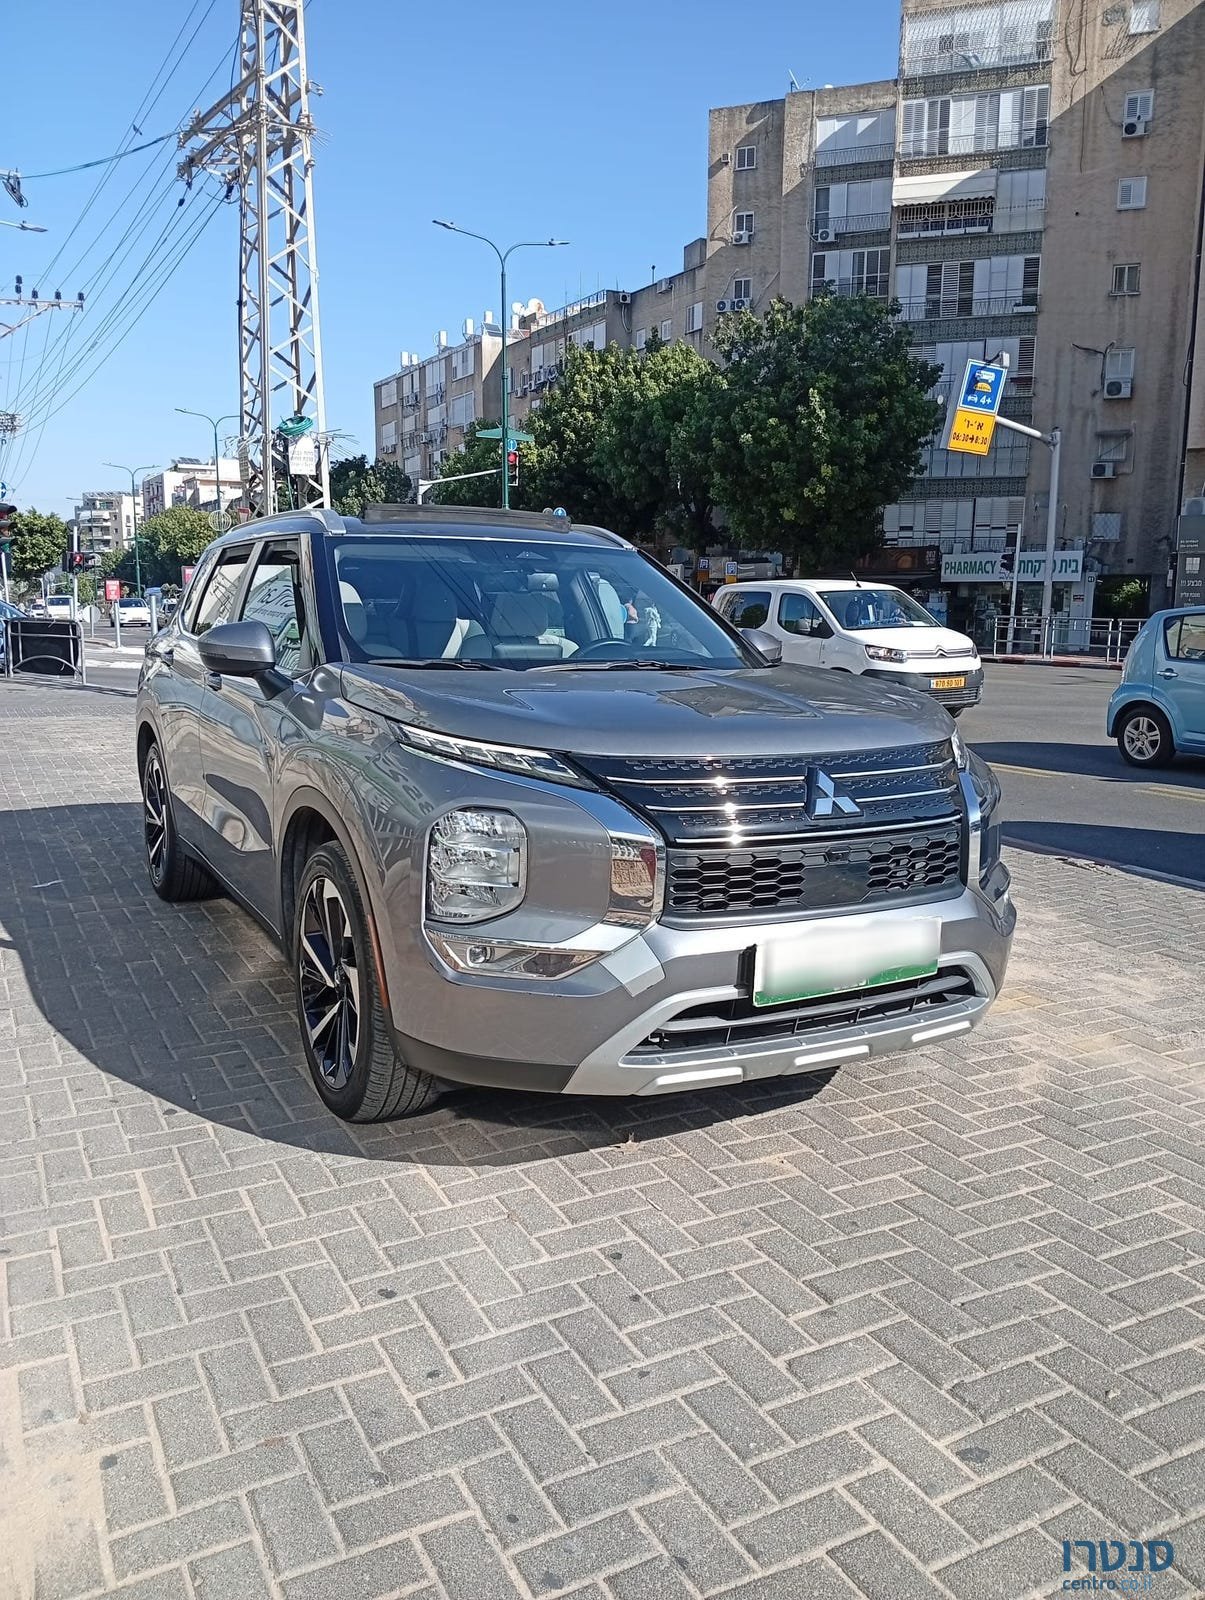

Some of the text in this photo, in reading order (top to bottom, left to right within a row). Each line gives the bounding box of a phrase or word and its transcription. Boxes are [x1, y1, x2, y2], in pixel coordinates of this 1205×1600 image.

[980, 395, 992, 405] 4+
[944, 560, 997, 575] PHARMACY
[1058, 559, 1079, 574] בית
